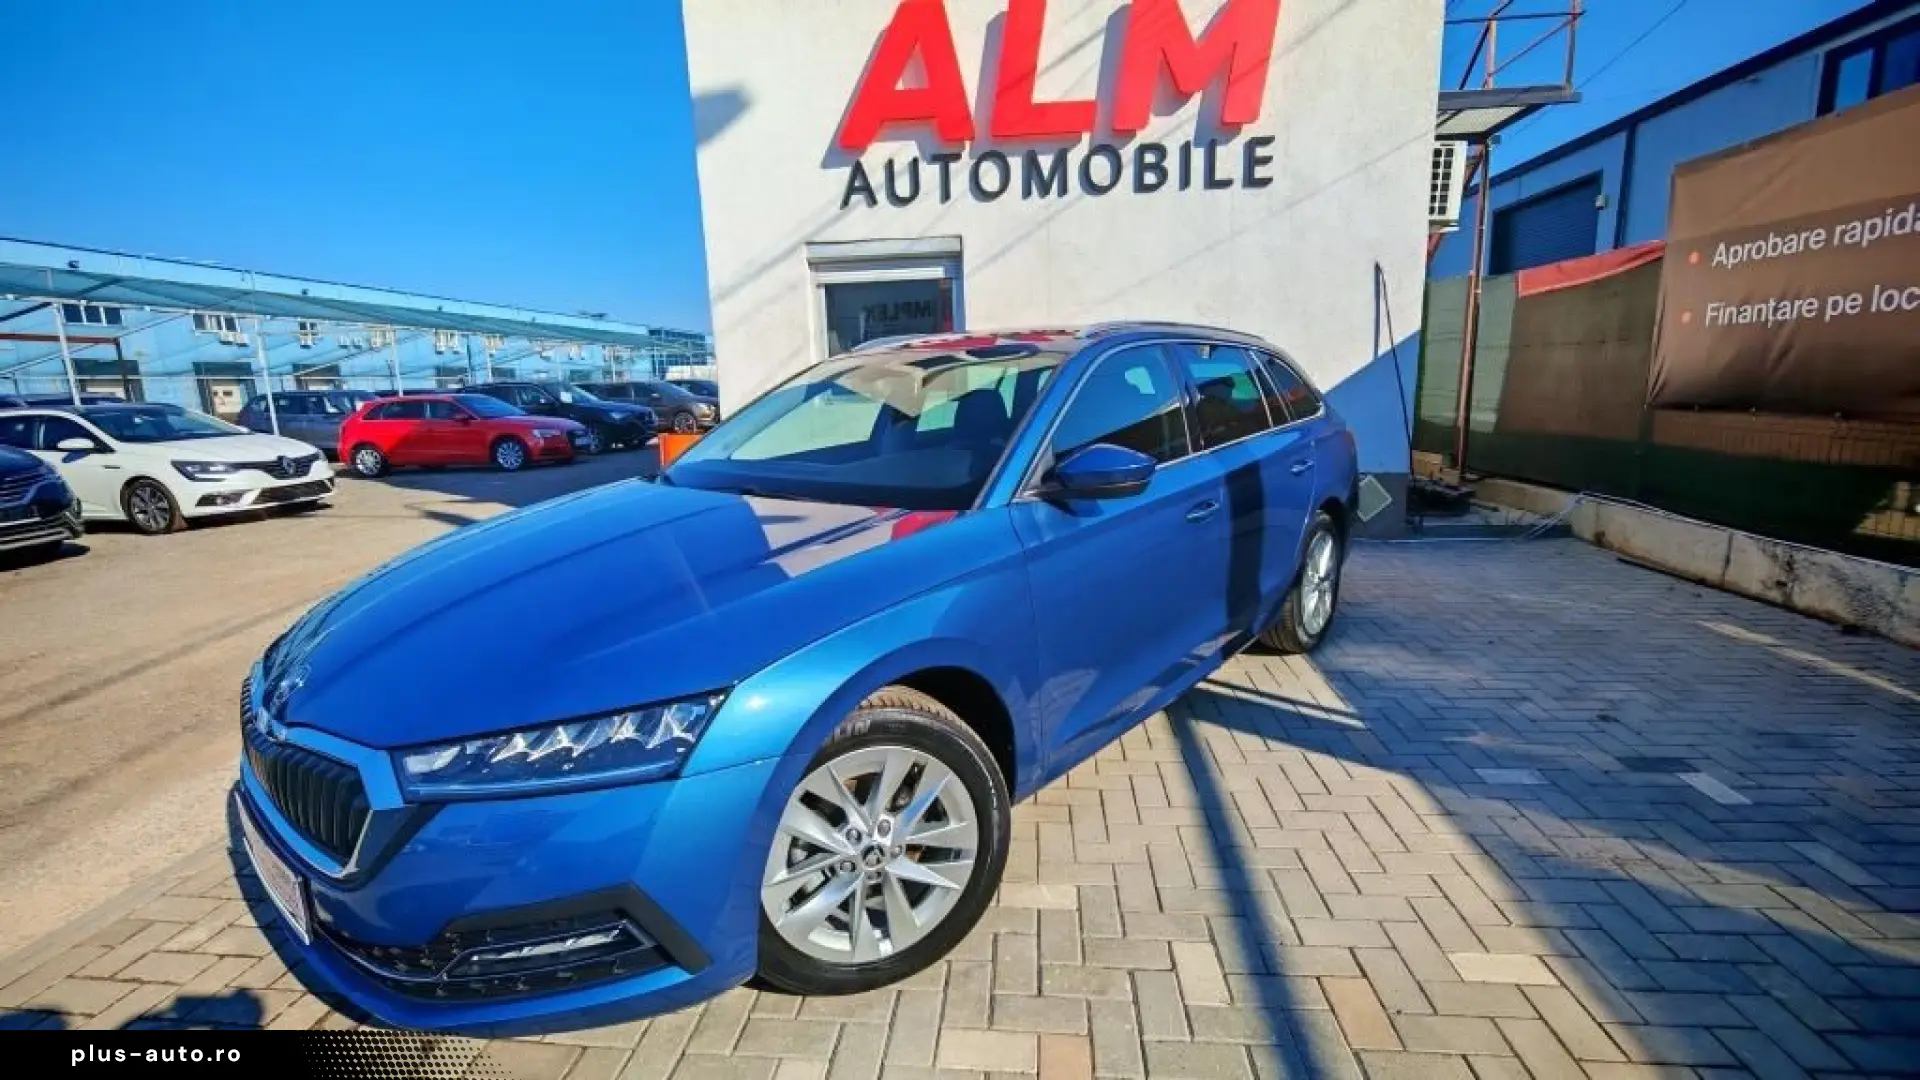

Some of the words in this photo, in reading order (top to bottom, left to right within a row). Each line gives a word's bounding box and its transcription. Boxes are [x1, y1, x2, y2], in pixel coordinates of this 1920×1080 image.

[840, 0, 1281, 154] ALM
[841, 136, 1276, 209] AUTOMOBILE
[1711, 228, 1828, 269] Aprobare
[1823, 292, 1863, 323] pe
[1870, 284, 1920, 313] loc
